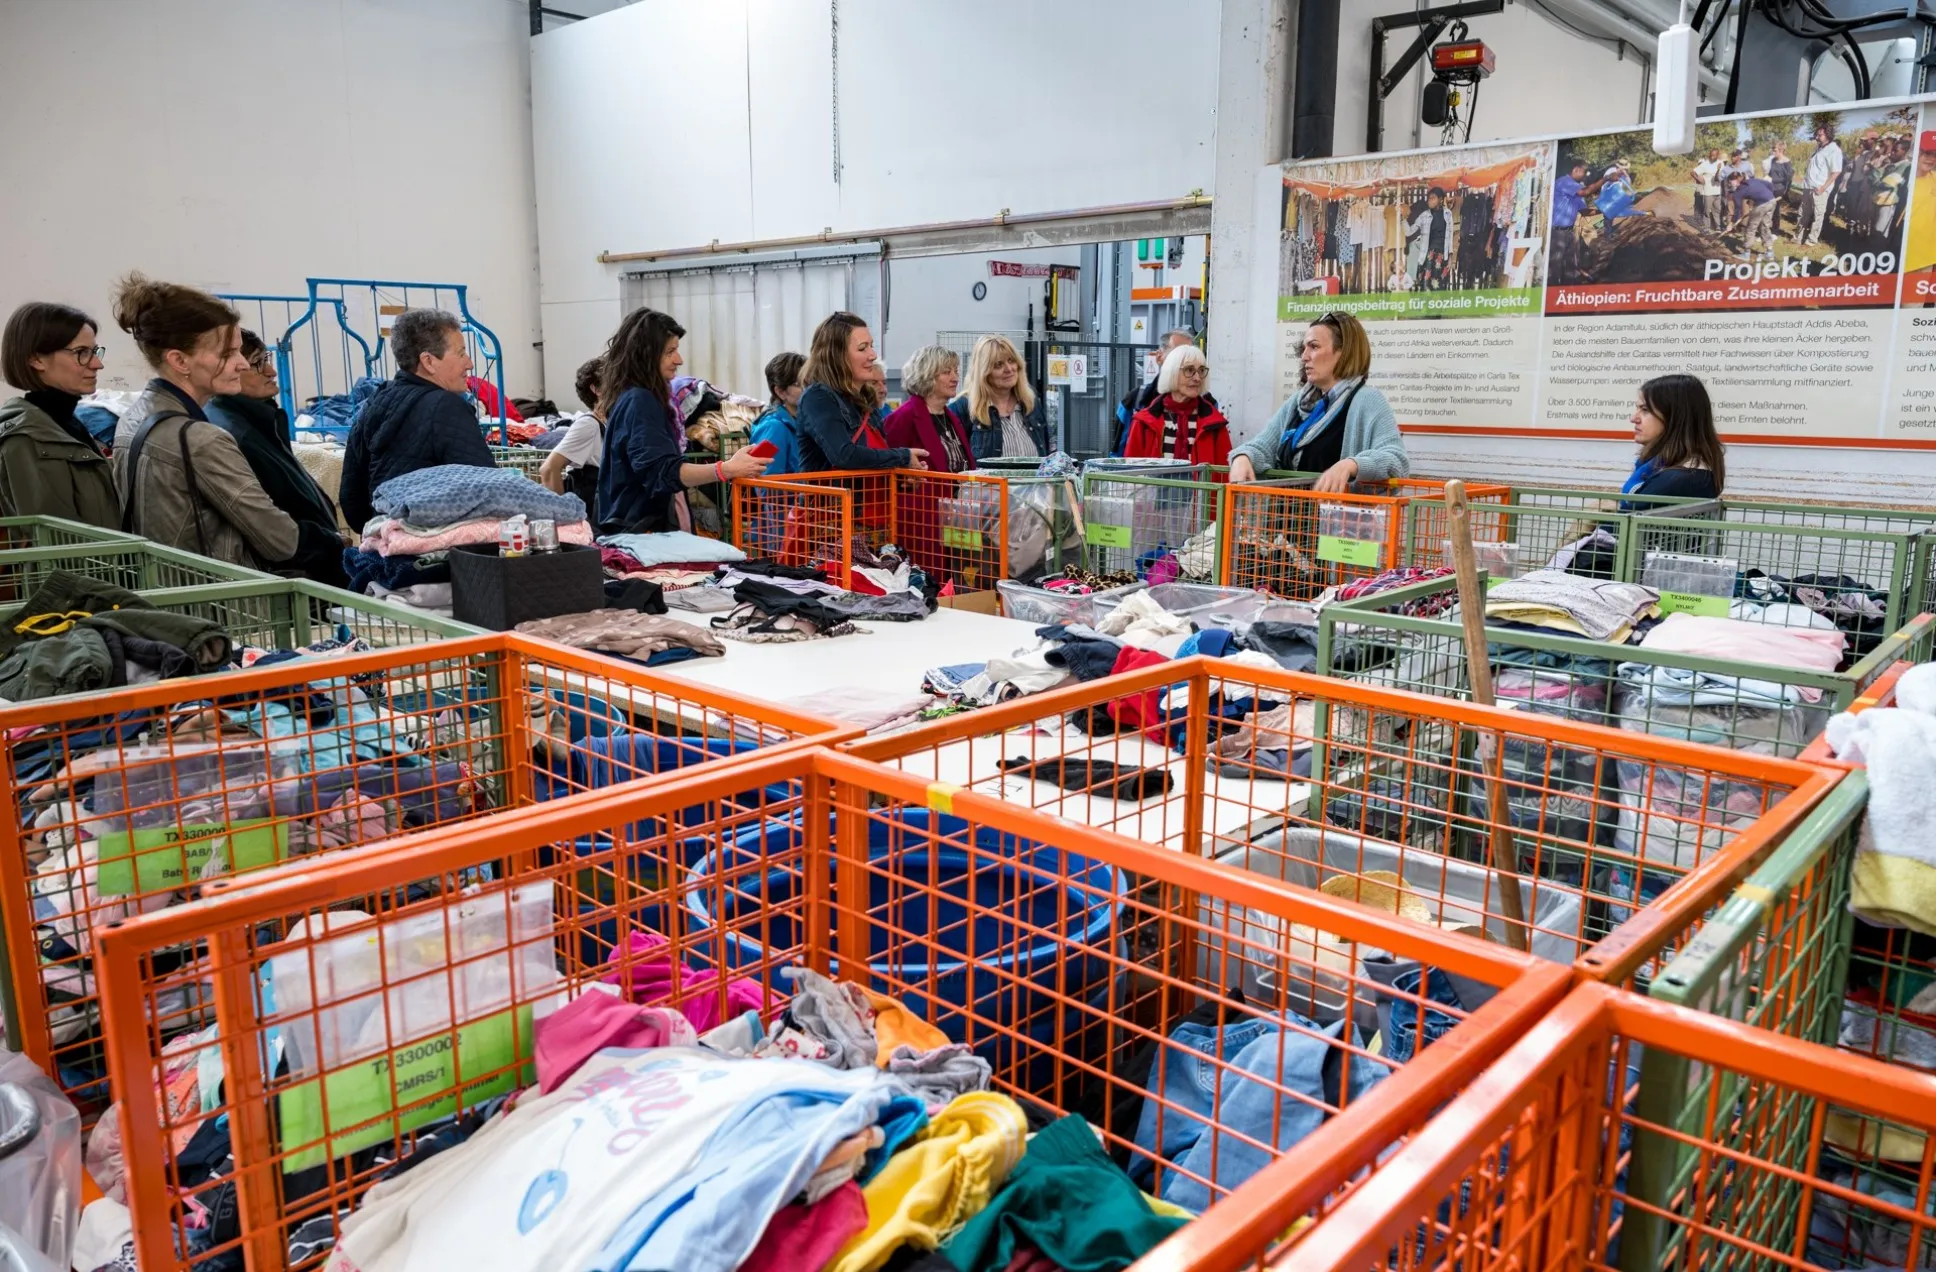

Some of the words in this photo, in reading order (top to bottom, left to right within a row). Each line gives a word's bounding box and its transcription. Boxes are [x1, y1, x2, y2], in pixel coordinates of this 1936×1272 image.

[1704, 255, 1810, 284] Projekt
[1819, 251, 1896, 277] 2009
[1556, 290, 1631, 307] Äthiopien:
[1635, 288, 1723, 303] Fruchtbare
[1727, 282, 1880, 301] Zusammenarbeit
[1287, 300, 1405, 314] Finanzierungsbeitrag
[1408, 298, 1426, 310] für
[1428, 298, 1471, 310] soziale
[1474, 295, 1530, 309] Projekte
[1563, 325, 1576, 334] der
[1577, 324, 1605, 333] Region
[1650, 323, 1679, 331] südlich
[1681, 322, 1695, 330] der
[1696, 322, 1751, 331] äthiopischen
[1753, 321, 1803, 329] Hauptstadt
[1805, 320, 1832, 328] Addis
[1834, 320, 1868, 328] Abeba,
[1575, 337, 1587, 345] die
[1588, 337, 1619, 345] meisten
[1621, 336, 1679, 344] Bauernfamilien
[1700, 336, 1720, 344] dem,
[1762, 333, 1797, 343] kleinen
[1797, 333, 1822, 343] Äcker
[1825, 335, 1872, 344] hergeben.
[1566, 350, 1616, 358] Auslandshilfe
[1632, 350, 1661, 358] Caritas
[1663, 350, 1700, 358] vermittelt
[1774, 349, 1794, 357] über
[1798, 349, 1869, 359] Kompostierung
[1568, 364, 1612, 372] biologische
[1686, 363, 1721, 374] Saatgut,
[1725, 364, 1807, 372] landwirtschaftliche
[1810, 363, 1842, 372] Geräte
[1906, 364, 1926, 372] und
[1434, 372, 1478, 380] Arbeitsplätze
[1508, 372, 1520, 380] Tex
[1550, 377, 1609, 385] Wasserpumpen
[1612, 377, 1642, 385] werden
[1712, 377, 1791, 388] Textiliensammlung
[1794, 378, 1852, 387] mitfinanziert.
[1903, 389, 1934, 399] Junge
[1450, 396, 1512, 406] Textiliensammlung
[1548, 397, 1566, 406] Über
[1568, 398, 1590, 406] 3.500
[1592, 398, 1625, 407] Familien
[1718, 401, 1746, 409] diesen
[1749, 401, 1807, 410] Maßnahmen.
[1901, 404, 1912, 412] ist
[1916, 404, 1930, 412] ein
[1547, 411, 1579, 419] Erstmals
[1600, 412, 1614, 420] ihre
[1738, 415, 1769, 423] Ernten
[1771, 416, 1806, 424] belohnt.
